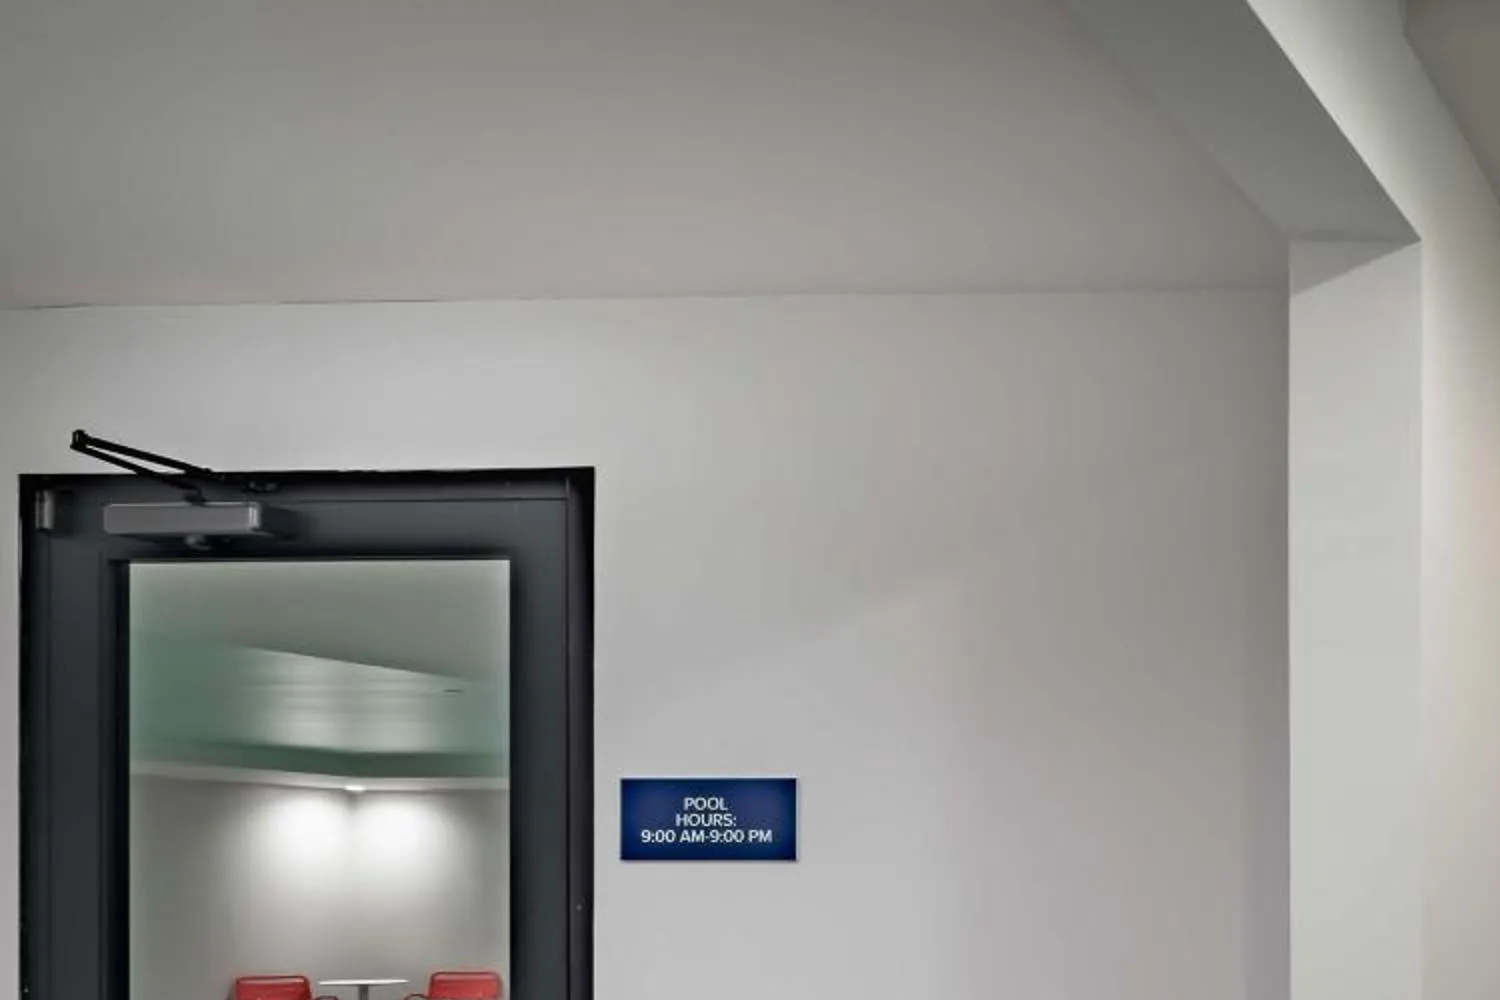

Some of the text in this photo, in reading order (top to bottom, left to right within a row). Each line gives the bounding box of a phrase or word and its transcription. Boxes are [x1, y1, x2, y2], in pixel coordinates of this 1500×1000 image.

[683, 796, 728, 811] POOL
[675, 813, 737, 827] HOURS:
[641, 829, 676, 843] 9:00
[748, 829, 773, 843] PM
